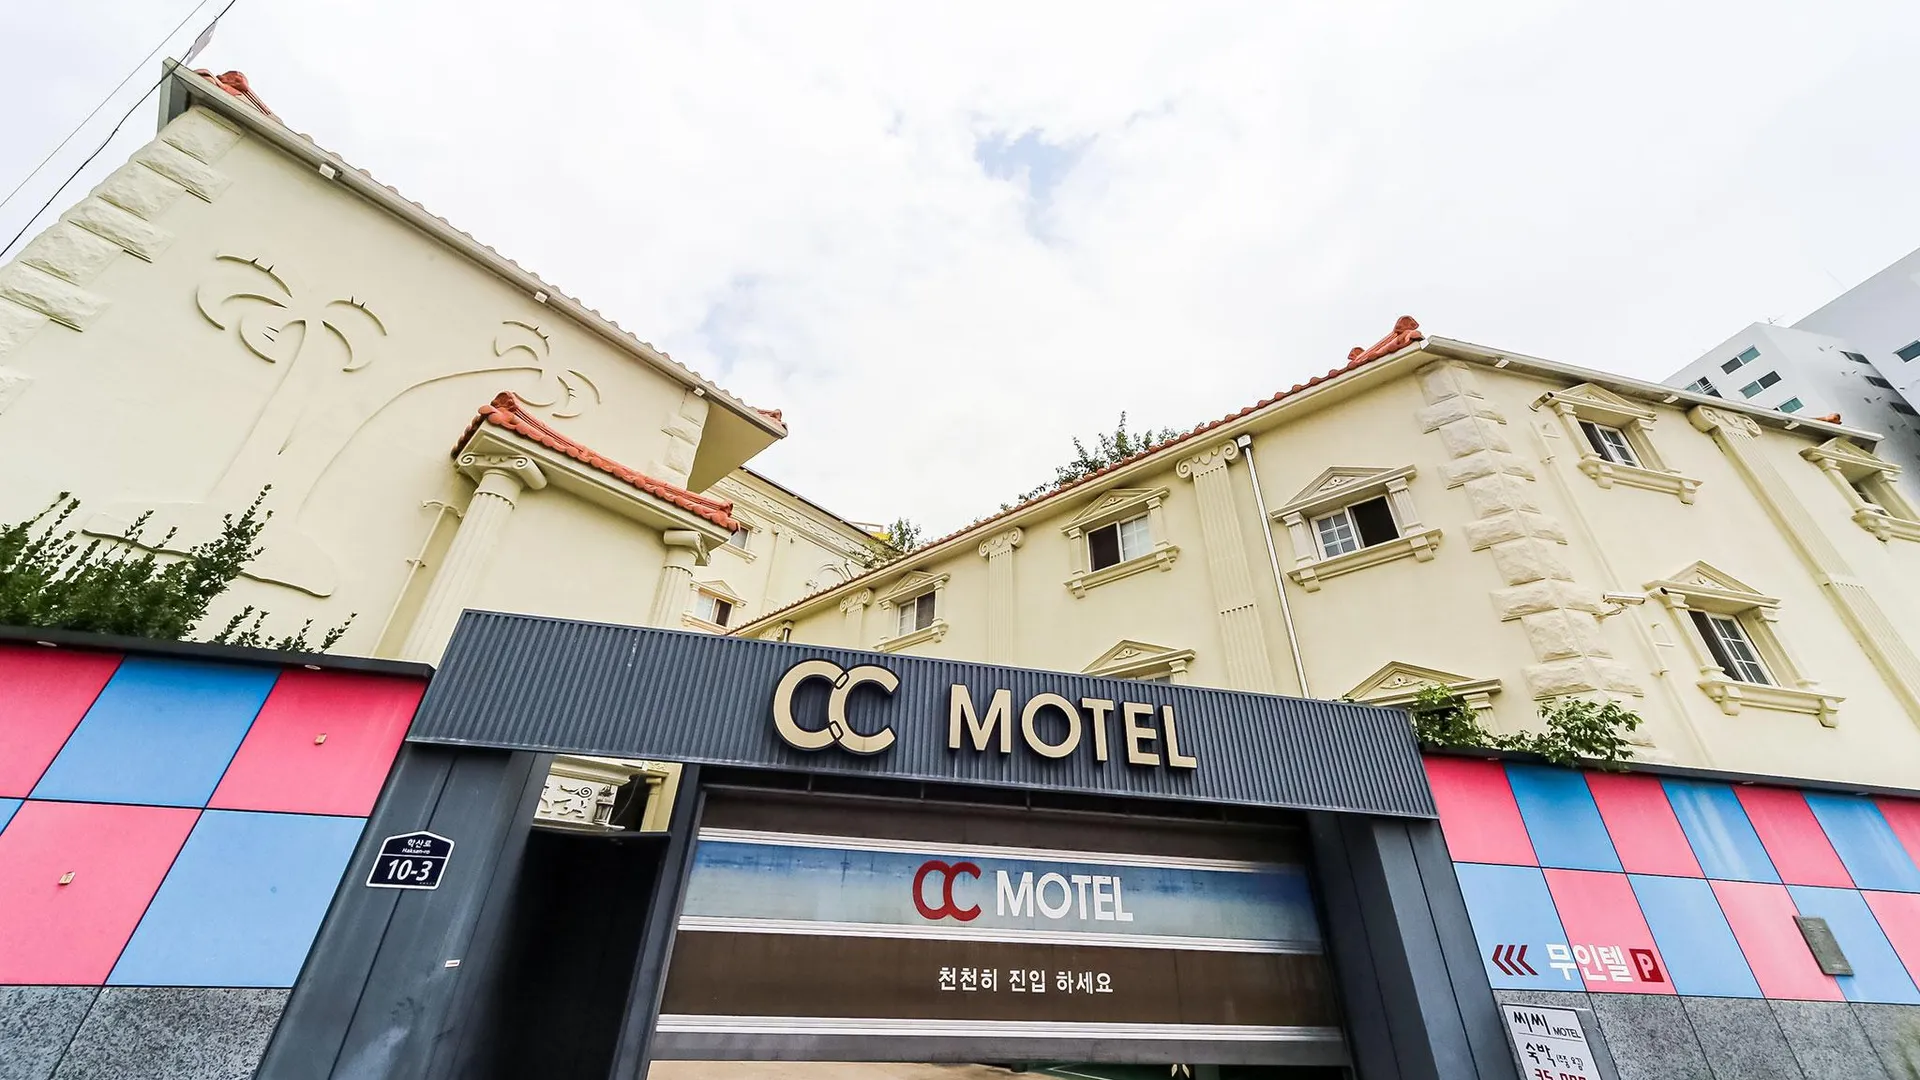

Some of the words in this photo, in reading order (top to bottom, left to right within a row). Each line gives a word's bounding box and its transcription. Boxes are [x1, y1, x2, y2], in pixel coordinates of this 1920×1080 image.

[773, 658, 900, 755] CC
[948, 684, 1197, 771] MOTEL
[387, 859, 433, 881] 10-3
[912, 860, 982, 921] CC
[996, 870, 1134, 921] MOTEL
[1545, 943, 1634, 982] 무인텔
[938, 967, 998, 992] 천천히
[1008, 969, 1046, 993] 진입
[1055, 971, 1114, 995] 하세요
[1513, 1011, 1551, 1036] 씨씨
[1553, 1027, 1582, 1039] MOTEL
[1526, 1042, 1556, 1067] 숙박
